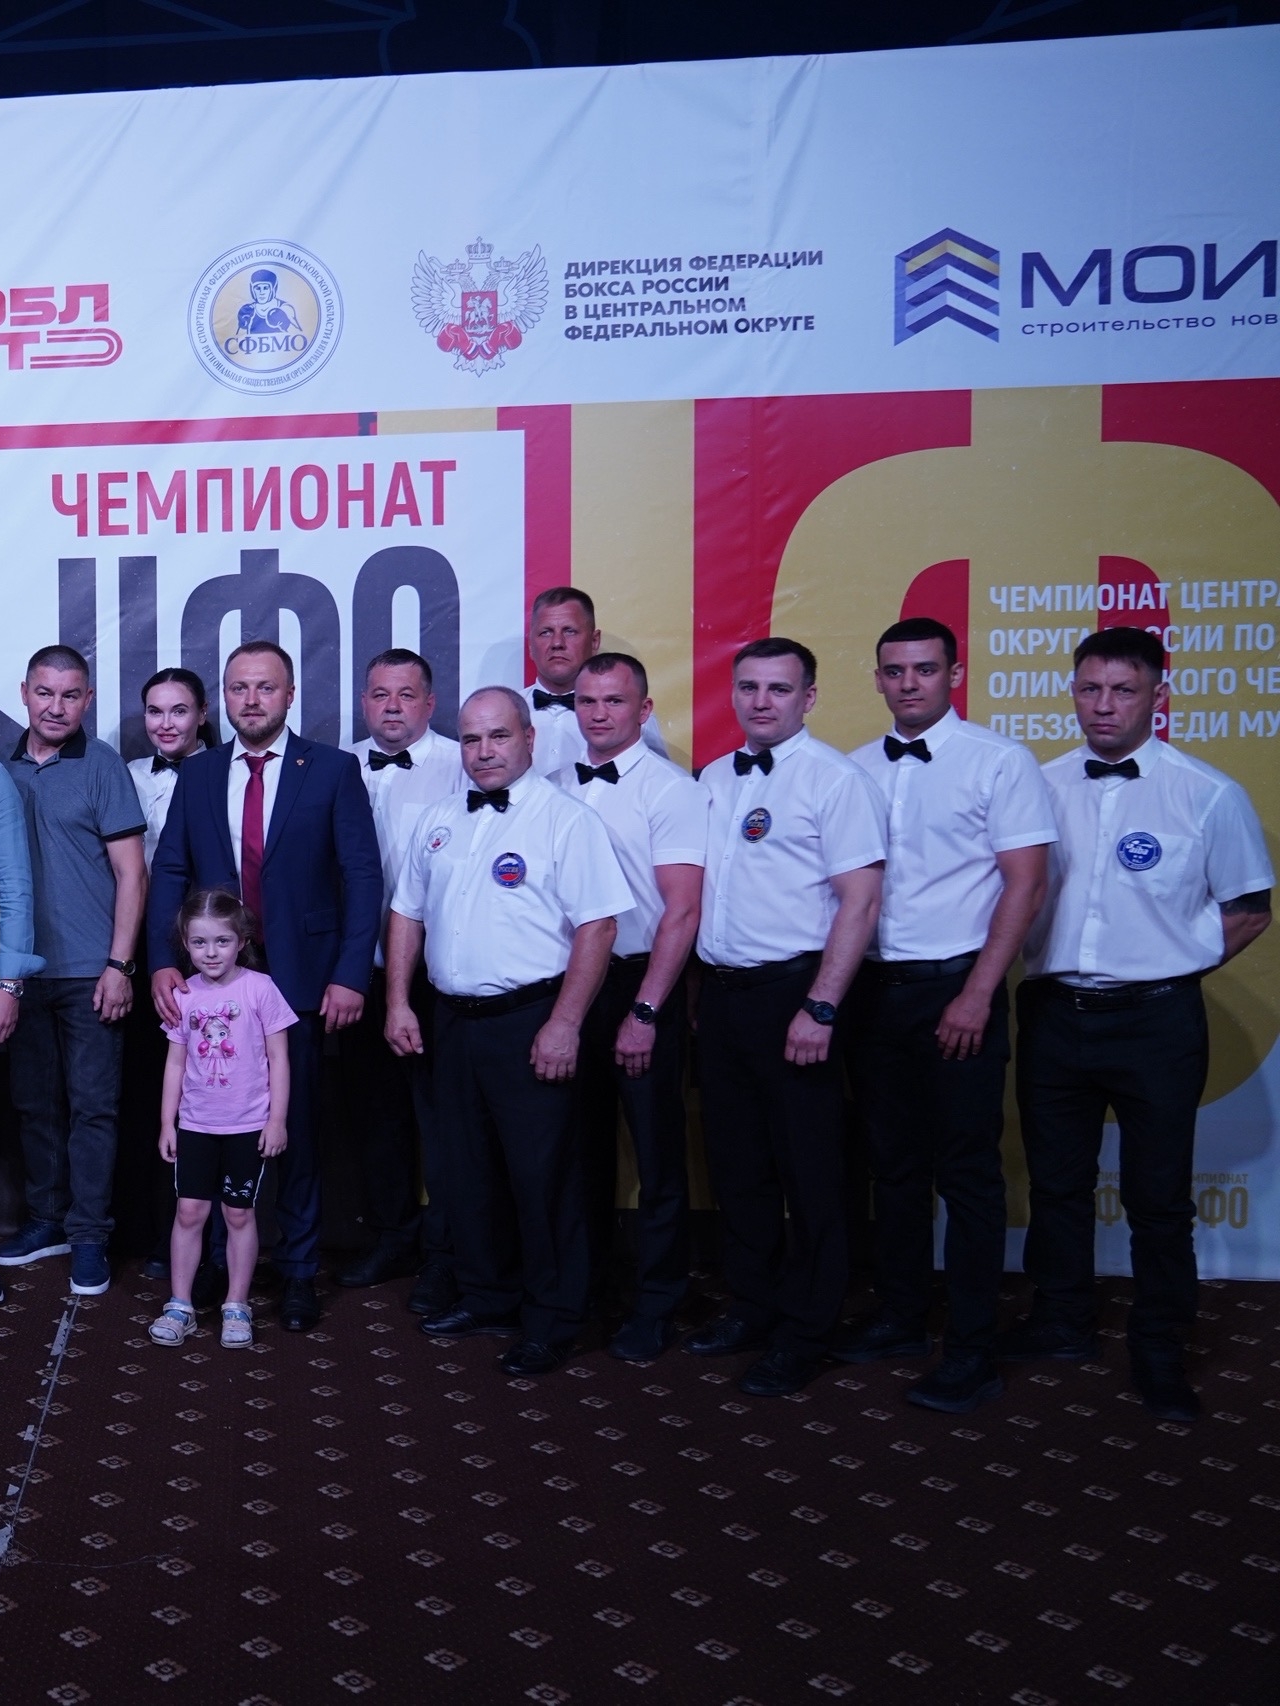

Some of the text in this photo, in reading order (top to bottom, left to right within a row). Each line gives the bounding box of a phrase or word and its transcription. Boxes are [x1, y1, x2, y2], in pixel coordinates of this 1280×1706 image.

[564, 250, 823, 279] ДИРЕКЦИЯ ФЕДЕРАЦИИ
[1021, 240, 1278, 308] МОИ
[195, 247, 335, 344] СПОРТИВНАЯ ФЕДЕРАЦИЯ БОКСА МОСКОВСКОЙ ОБЛАСТИ
[565, 276, 729, 298] БОКСА РОССИИ
[565, 297, 746, 321] В ЦЕНТРАЛЬНОМ
[564, 315, 815, 341] ФЕДЕРАЛЬНОМ ОКРУГЕ
[1021, 313, 1278, 336] строительство нов
[224, 334, 308, 355] СФБМО
[201, 340, 329, 388] РЕГИОНАЛЬНАЯ ОБЩЕСТВЕННАЯ ОРГАНИЗАЦИЯ
[51, 459, 457, 537] ЧЕМПИОНАТ
[989, 582, 1171, 613] ЧЕМПИОНАТ
[1234, 623, 1276, 652] ПО
[1151, 711, 1230, 743] РЕДИ
[1193, 1185, 1249, 1229] ФО
